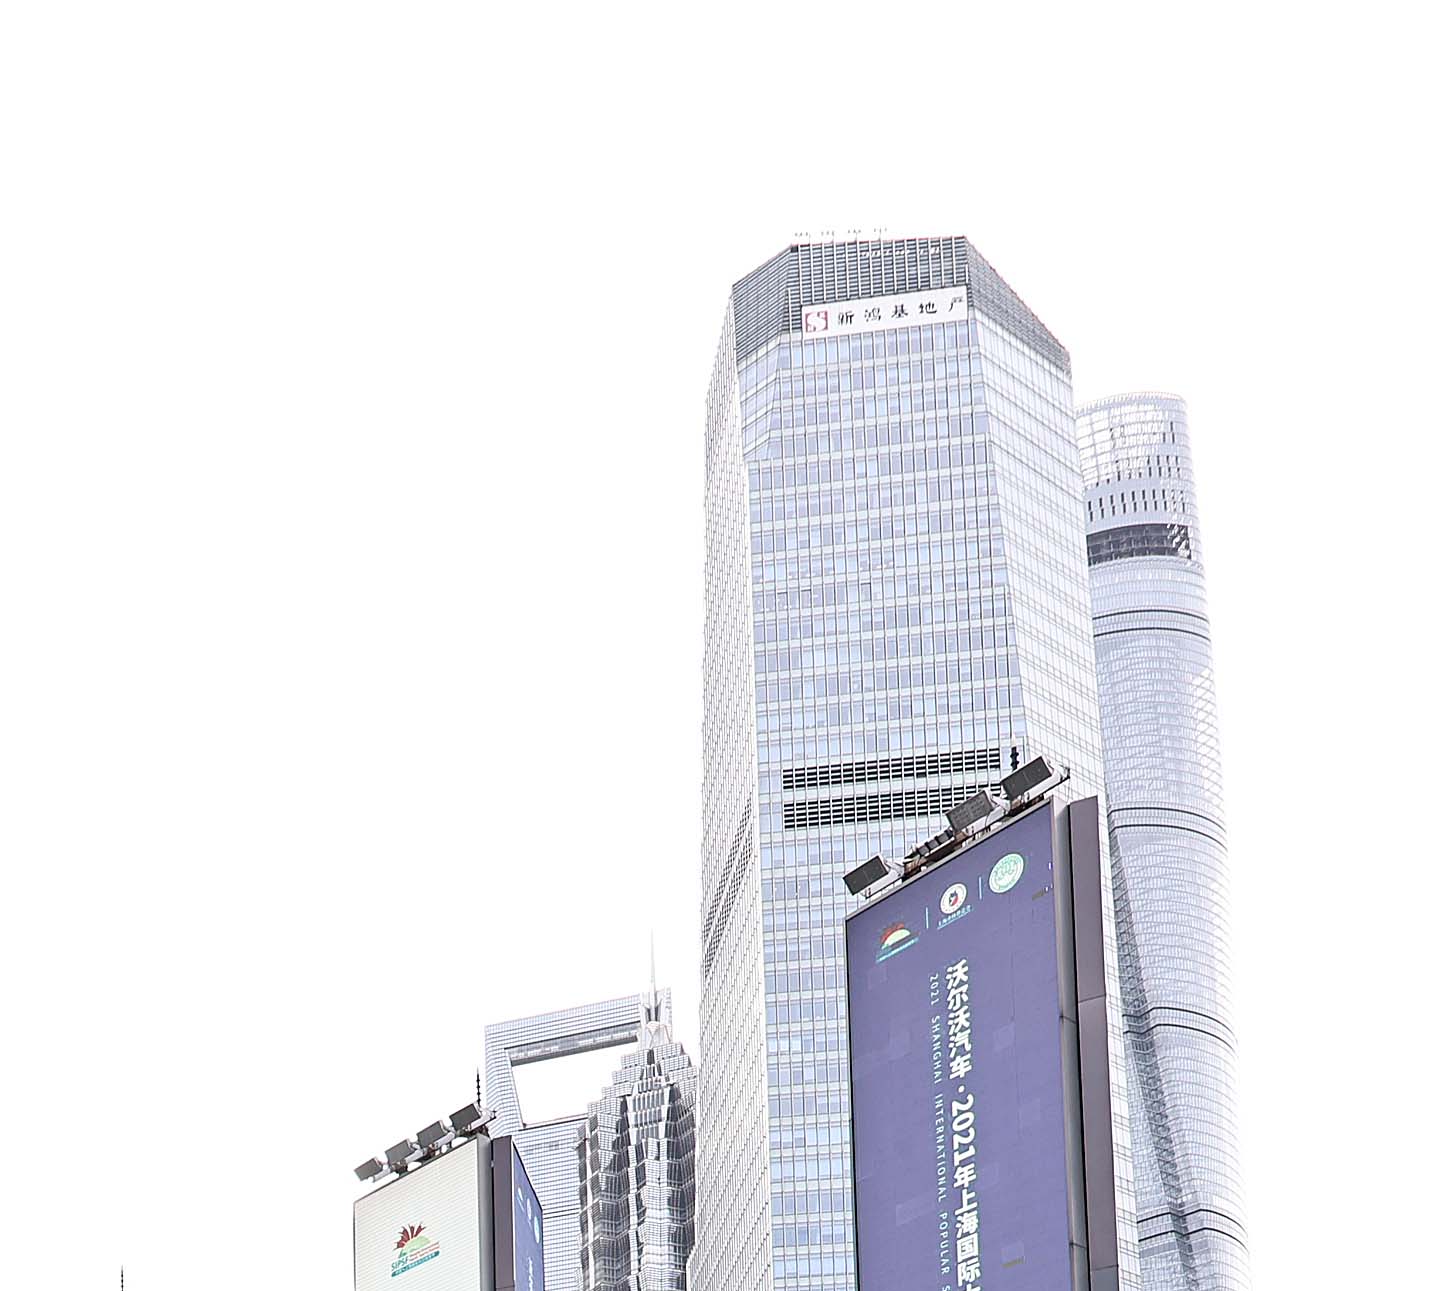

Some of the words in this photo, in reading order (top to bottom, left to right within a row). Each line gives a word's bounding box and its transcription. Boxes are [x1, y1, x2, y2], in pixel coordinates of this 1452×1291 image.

[931, 1015, 943, 1084] SHANGHAI
[934, 1093, 947, 1202] INTERNATIONAL
[939, 1212, 950, 1274] POPULAR
